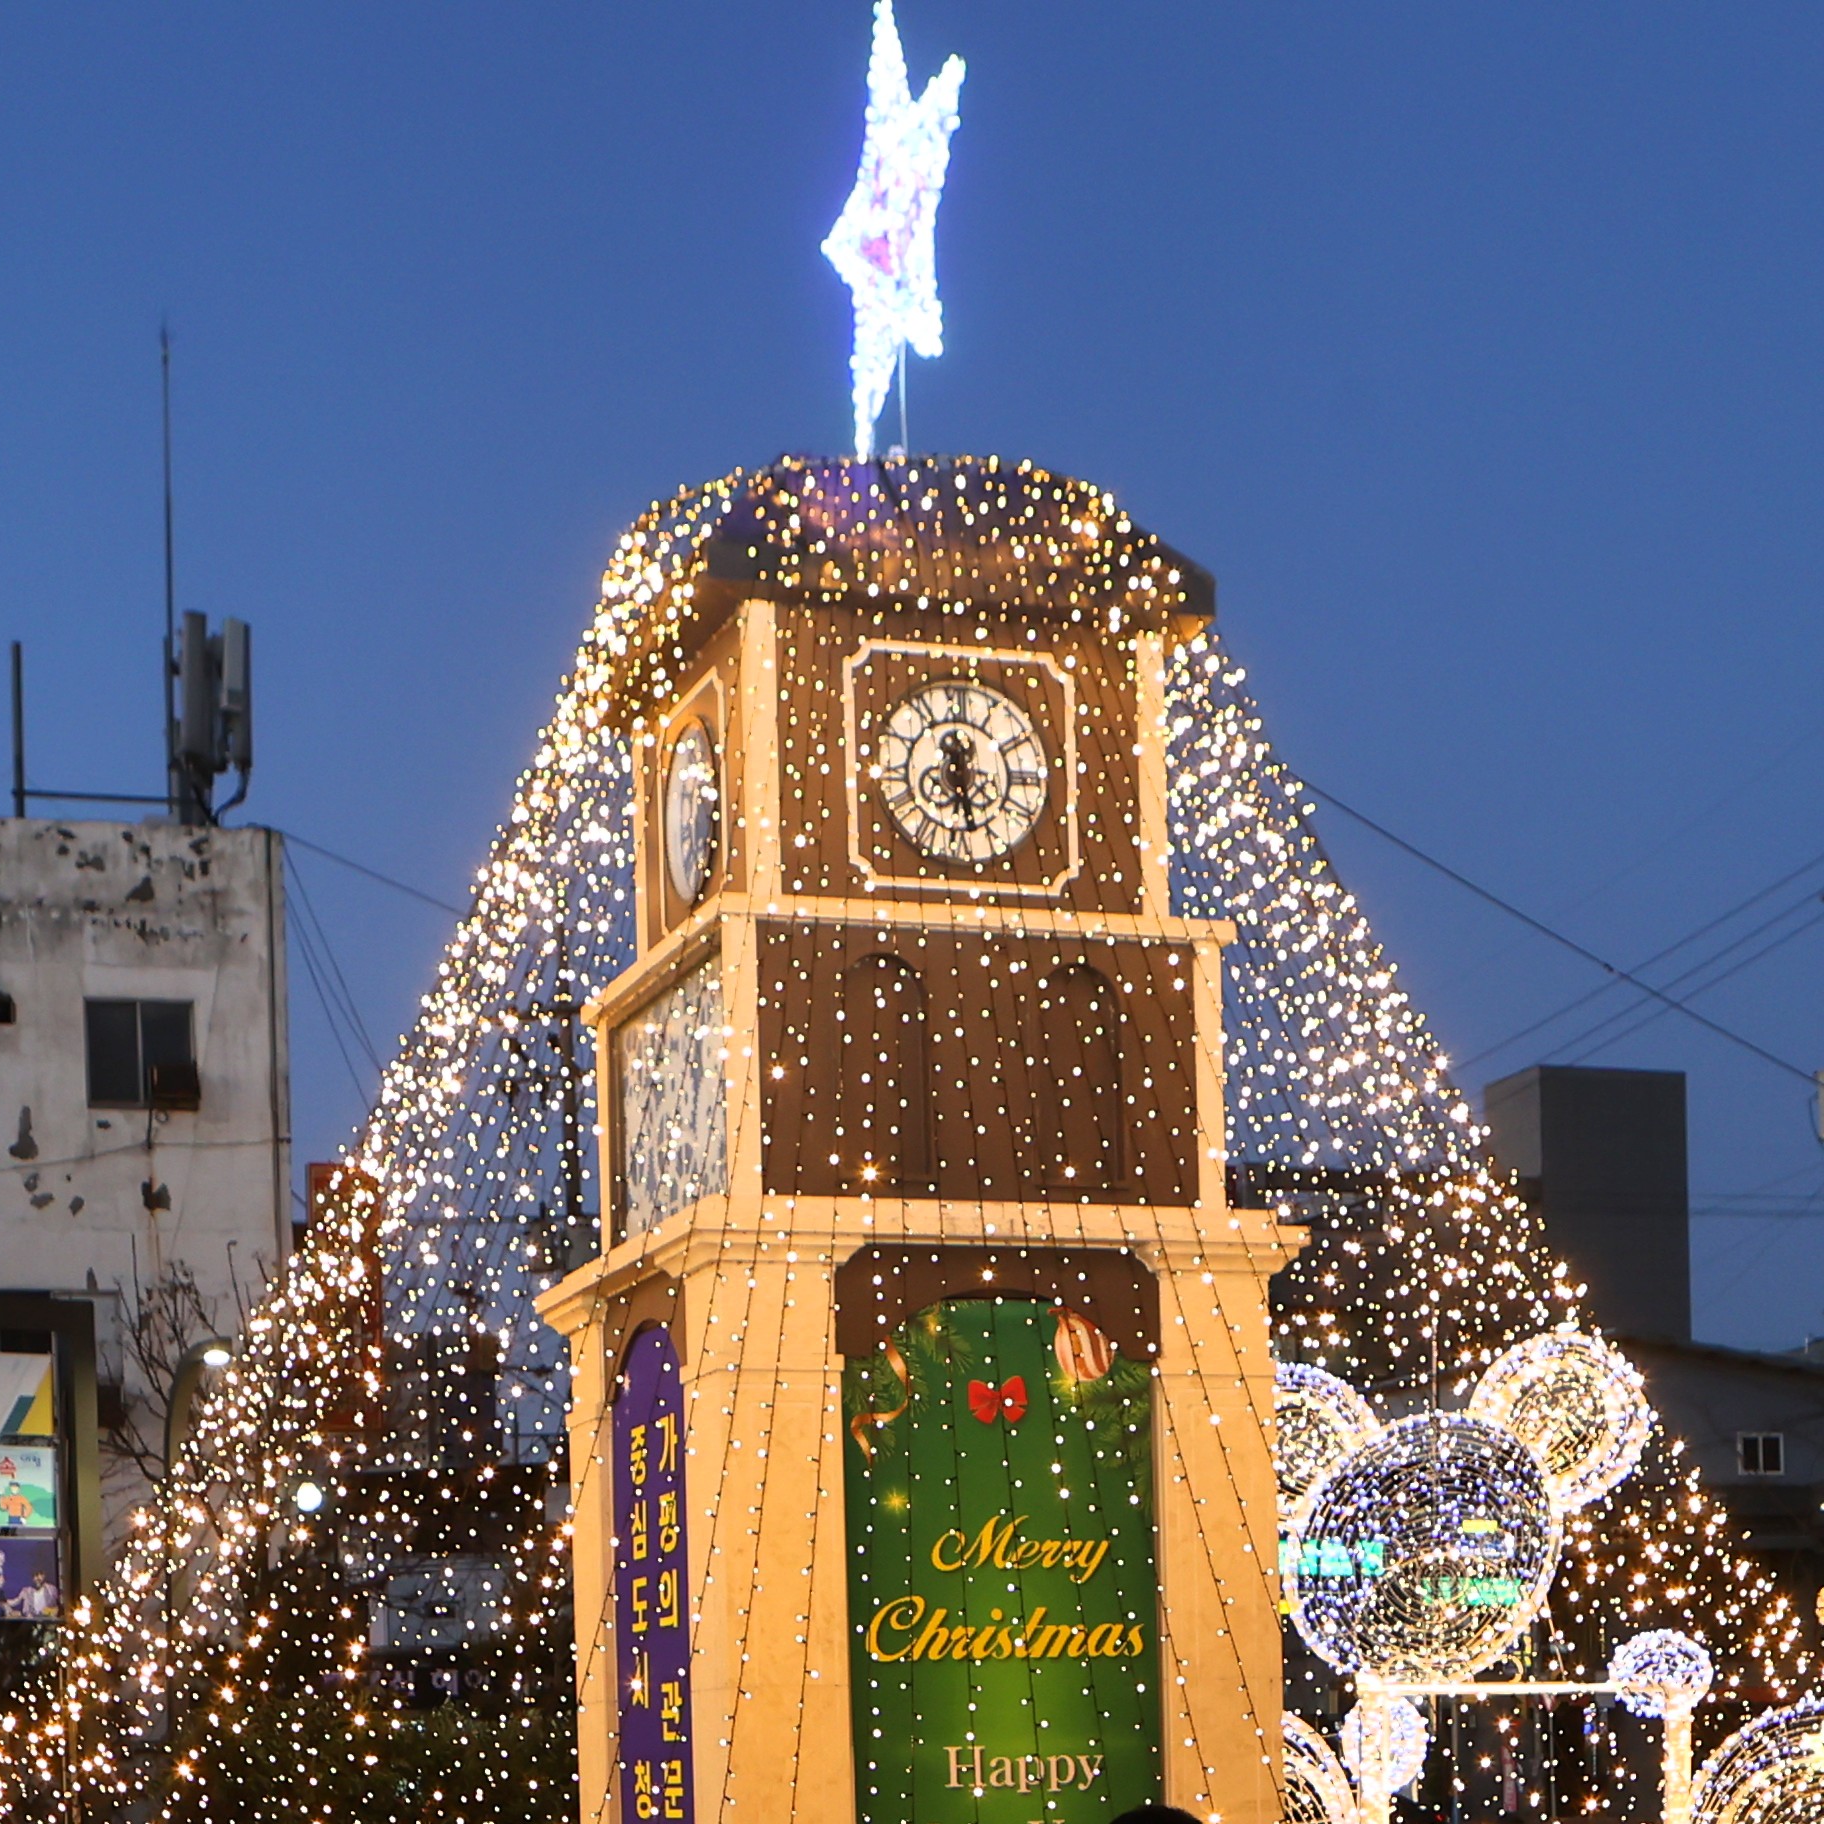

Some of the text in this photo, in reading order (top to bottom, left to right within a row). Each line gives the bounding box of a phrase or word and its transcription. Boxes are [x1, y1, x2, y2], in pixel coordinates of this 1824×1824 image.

[629, 1423, 650, 1709] 중심도시
[930, 1514, 1111, 1584] Merry
[865, 1594, 1145, 1663] Christmas
[943, 1745, 1105, 1793] Happy
